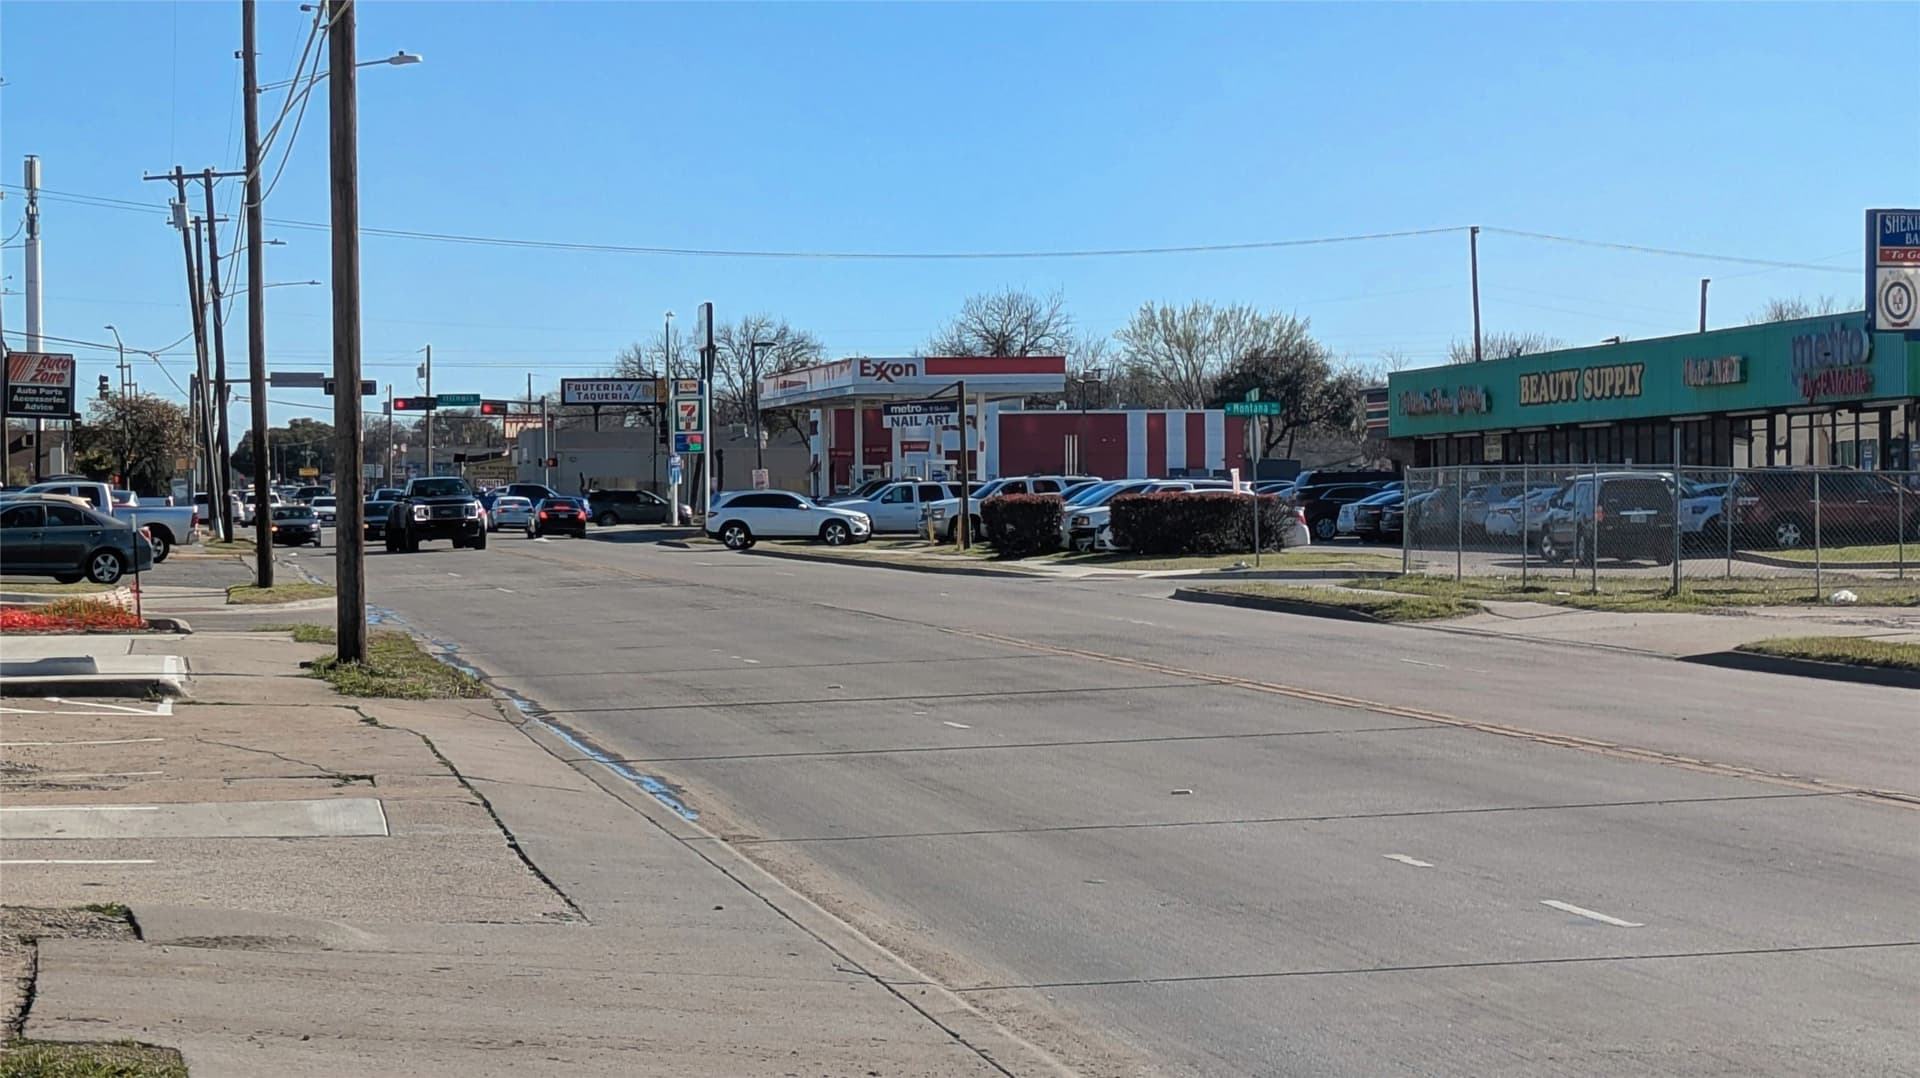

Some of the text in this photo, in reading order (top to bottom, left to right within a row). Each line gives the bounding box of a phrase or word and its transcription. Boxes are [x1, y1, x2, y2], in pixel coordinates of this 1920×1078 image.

[1885, 215, 1920, 234] SHEKI
[1905, 232, 1920, 245] BA
[37, 356, 70, 369] Auto
[30, 369, 65, 383] Zone
[860, 359, 917, 383] Exxon
[1519, 362, 1645, 406] BEAUTY SUPPLY
[16, 387, 63, 396] Auto Parts
[576, 391, 630, 400] TAQUERIA
[13, 395, 66, 403] Accessories
[24, 403, 54, 411] Advice
[890, 404, 922, 414] metro
[1233, 403, 1268, 414] Montana
[891, 414, 950, 428] NAIL ART
